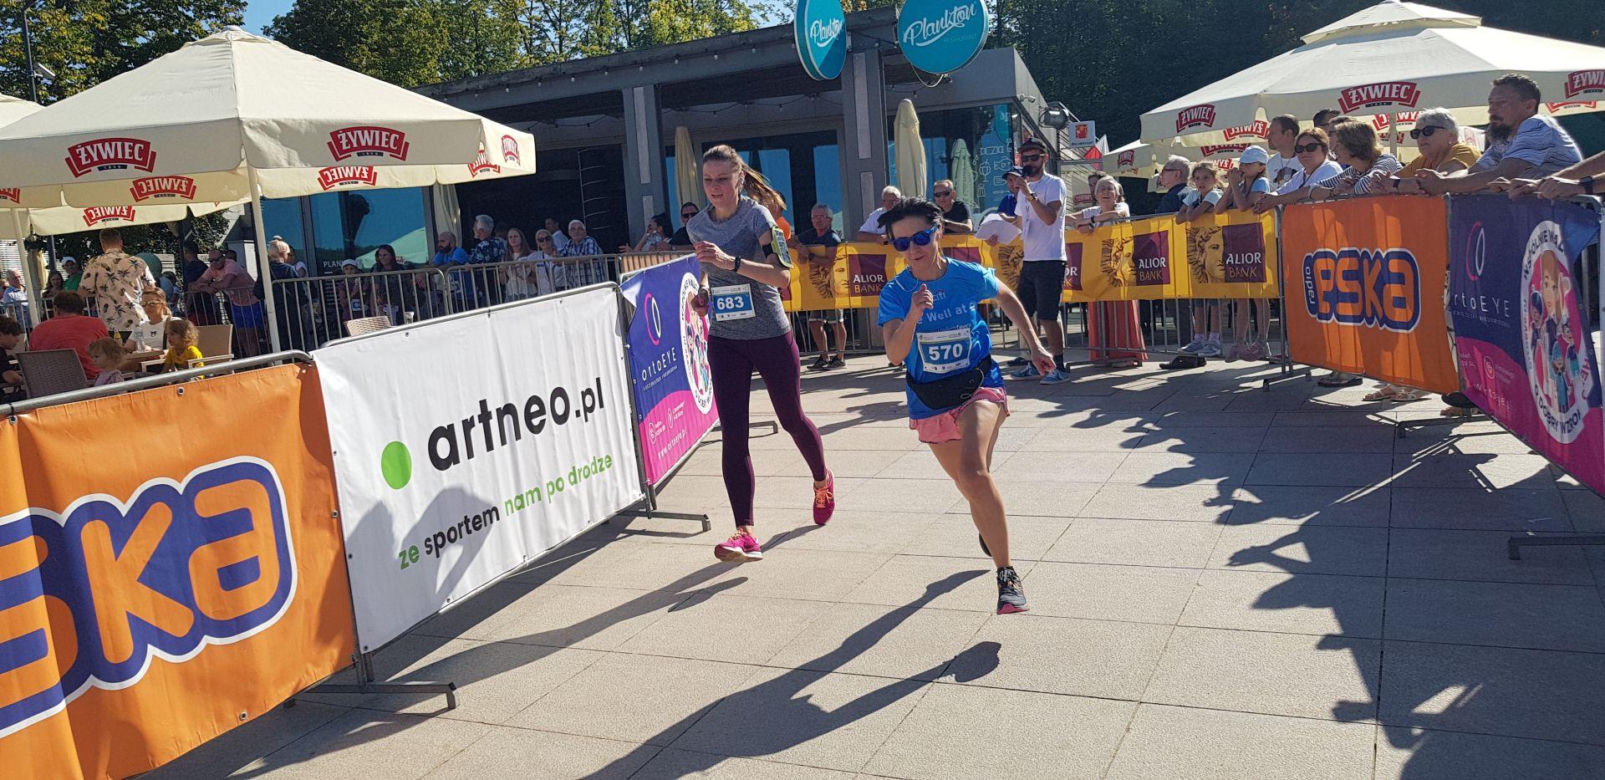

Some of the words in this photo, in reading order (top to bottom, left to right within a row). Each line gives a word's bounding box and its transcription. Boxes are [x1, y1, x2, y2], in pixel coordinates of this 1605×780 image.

[809, 18, 843, 47] Plankton
[903, 4, 977, 47] Plankton
[1572, 72, 1605, 89] ŻYWI
[1348, 84, 1410, 103] ŻYWIEC
[337, 129, 400, 150] ŻYWIEC
[76, 141, 144, 165] ŻYWIEC
[1138, 257, 1167, 269] ALIOR
[1226, 252, 1262, 265] ALIOR
[853, 274, 885, 283] ALIOR
[1139, 270, 1164, 281] BANK
[1229, 266, 1258, 278] BANK
[854, 285, 882, 294] BANK
[1304, 265, 1316, 305] radio
[716, 295, 745, 310] 683
[1454, 292, 1511, 318] rtoEYE
[925, 308, 953, 322] Well
[955, 303, 968, 315] at
[928, 343, 963, 361] 570
[427, 377, 605, 472] artneo.pl
[399, 544, 420, 570] ze
[424, 505, 500, 558] sportem
[505, 486, 542, 516] nam
[546, 476, 565, 504] po
[568, 454, 613, 486] drodze
